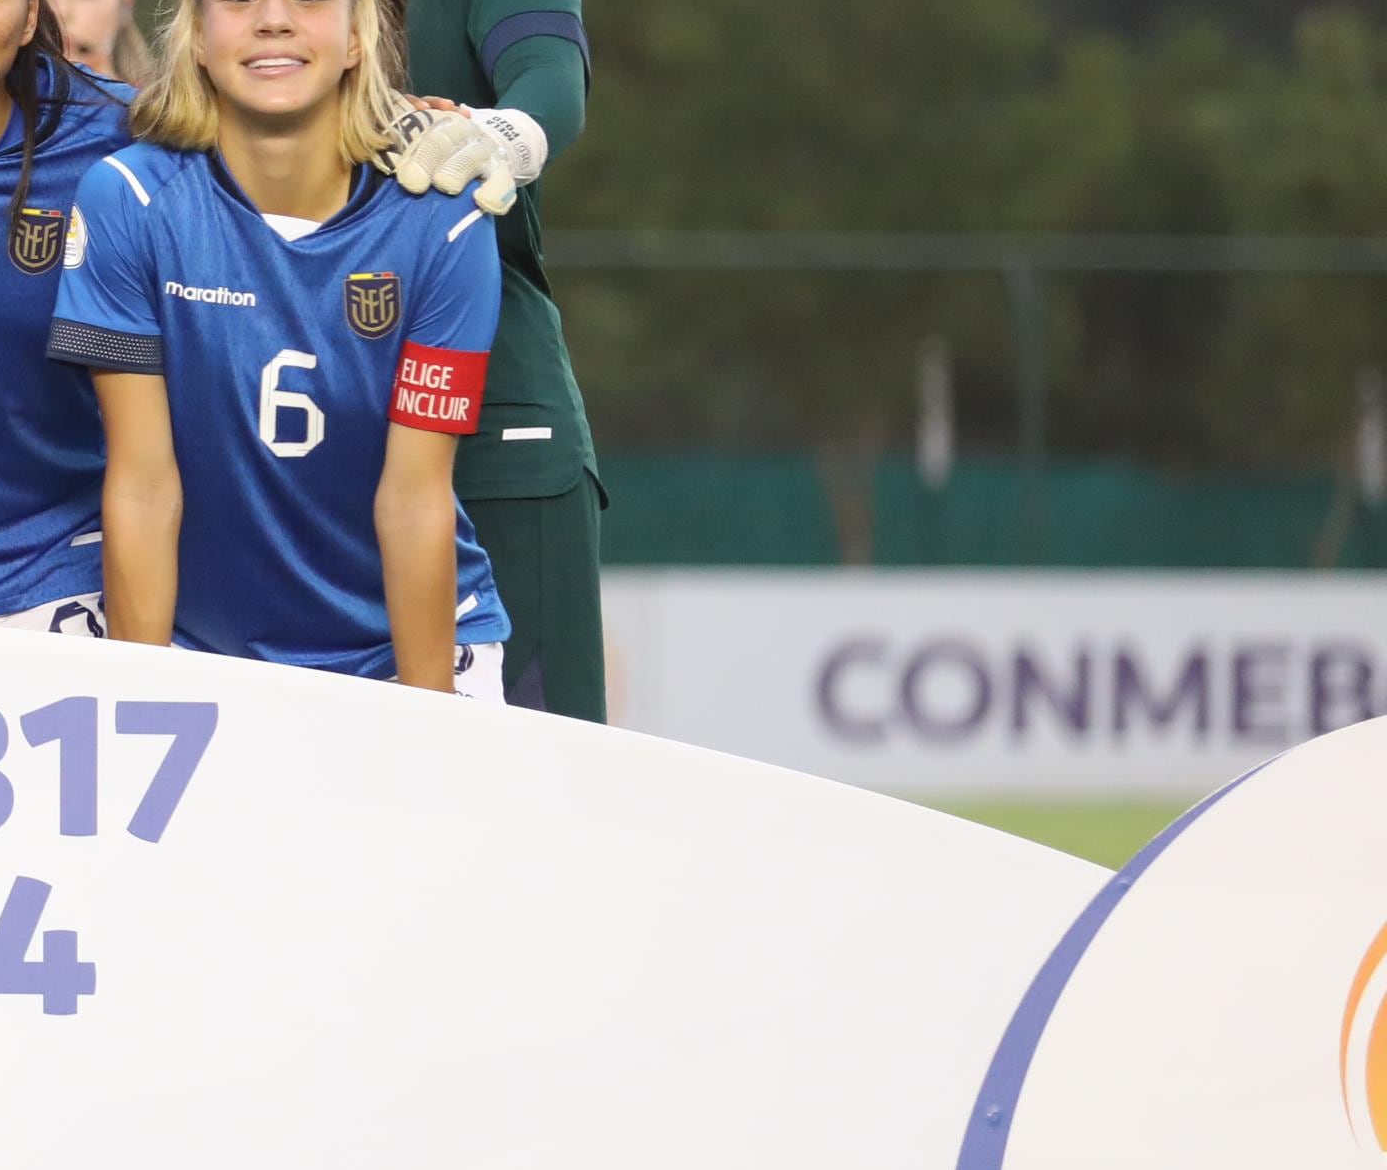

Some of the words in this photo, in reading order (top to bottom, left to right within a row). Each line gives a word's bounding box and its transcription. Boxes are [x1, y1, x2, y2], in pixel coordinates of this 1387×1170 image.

[164, 281, 257, 308] marathon
[400, 358, 455, 390] ELIGE
[259, 348, 325, 458] 6
[396, 387, 470, 421] INCLUIR
